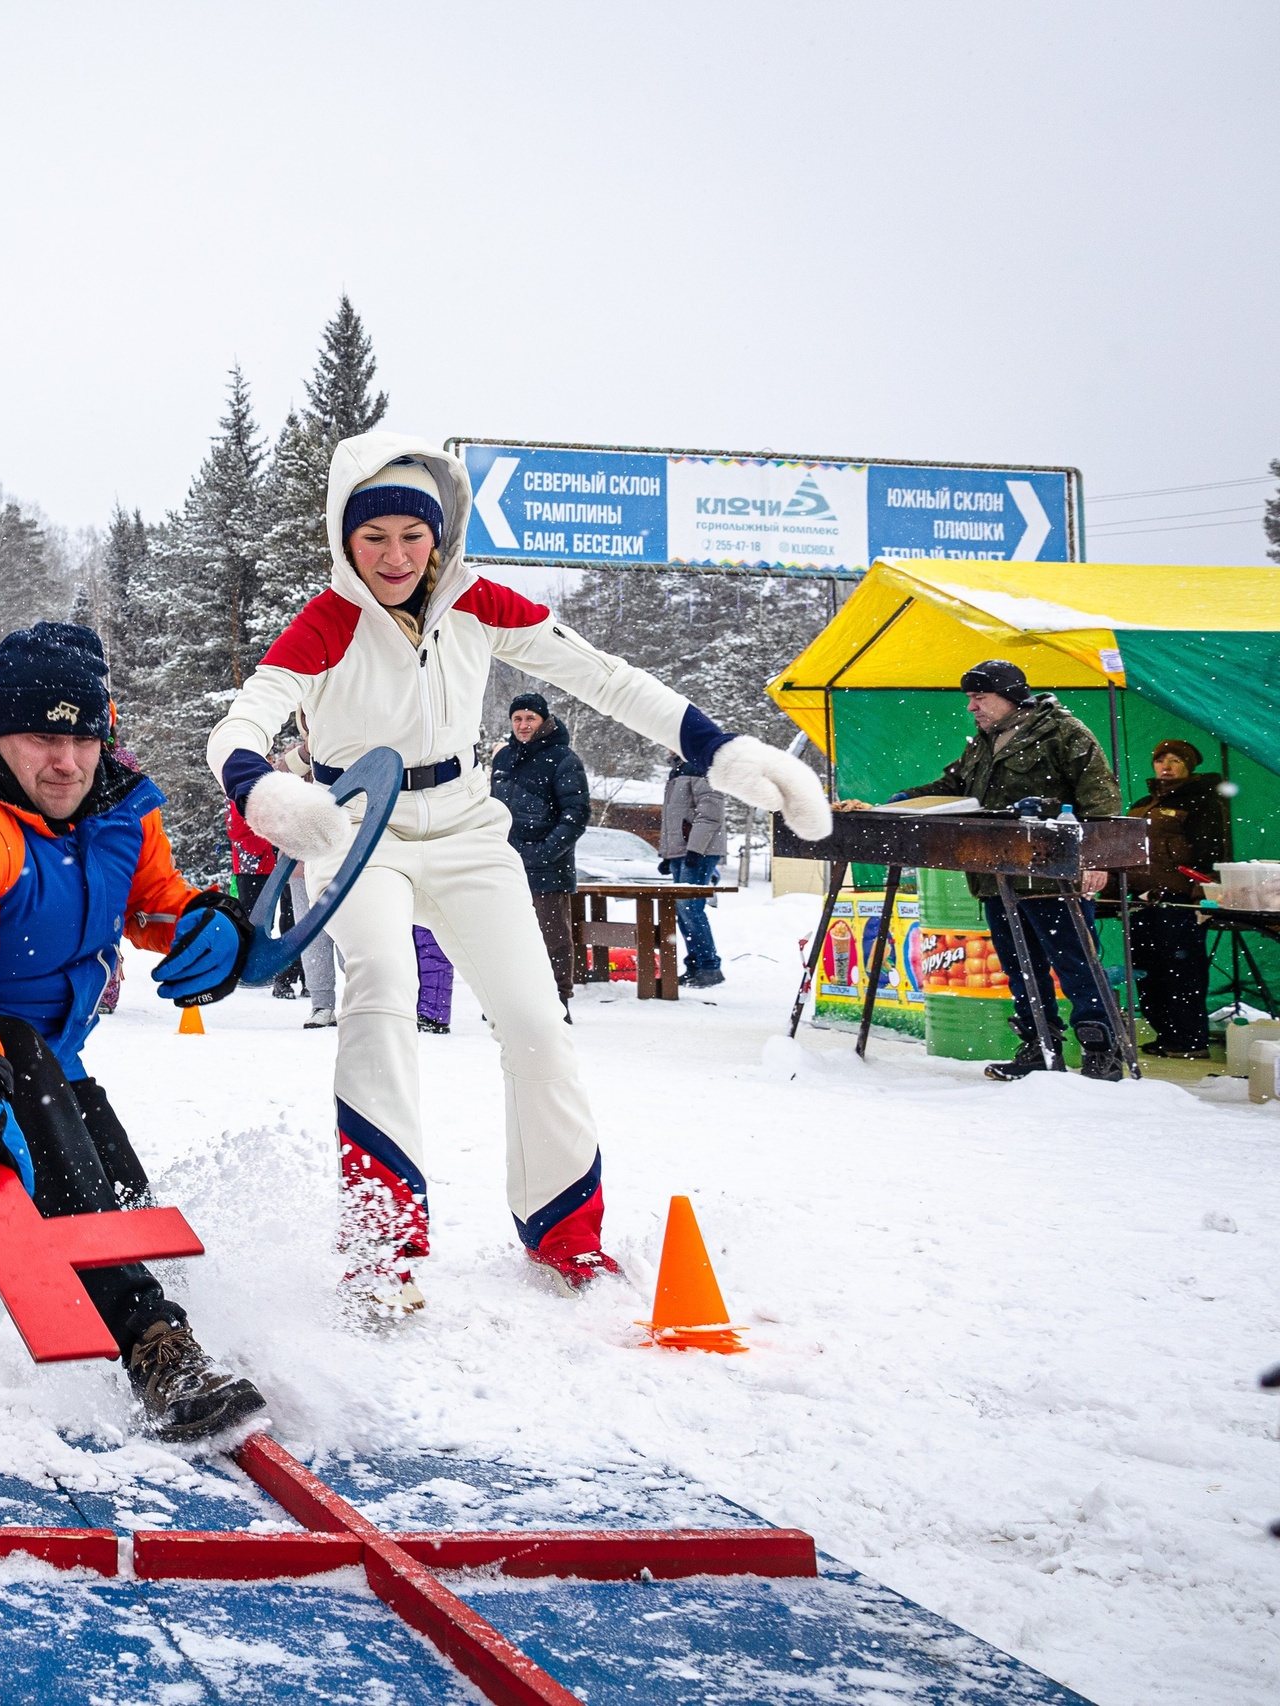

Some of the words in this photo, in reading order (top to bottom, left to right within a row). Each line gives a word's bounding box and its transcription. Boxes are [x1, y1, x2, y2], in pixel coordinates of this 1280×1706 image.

[523, 470, 606, 494] СЕВЕРНЫЙ
[609, 475, 661, 497] СКЛОН
[886, 486, 951, 510] ЮЖНЫЙ
[953, 490, 1004, 513] СКЛОН
[523, 501, 622, 525] ТРАМПЛИНЫ
[696, 520, 780, 533] горнолыжный
[782, 525, 840, 536] комплекс
[933, 519, 1005, 542] ПЛЮШКИ
[523, 531, 569, 555] БАНЯ,
[573, 533, 644, 557] БЕСЕДКИ
[716, 539, 761, 552] 255-47-18
[921, 946, 965, 975] уруза
